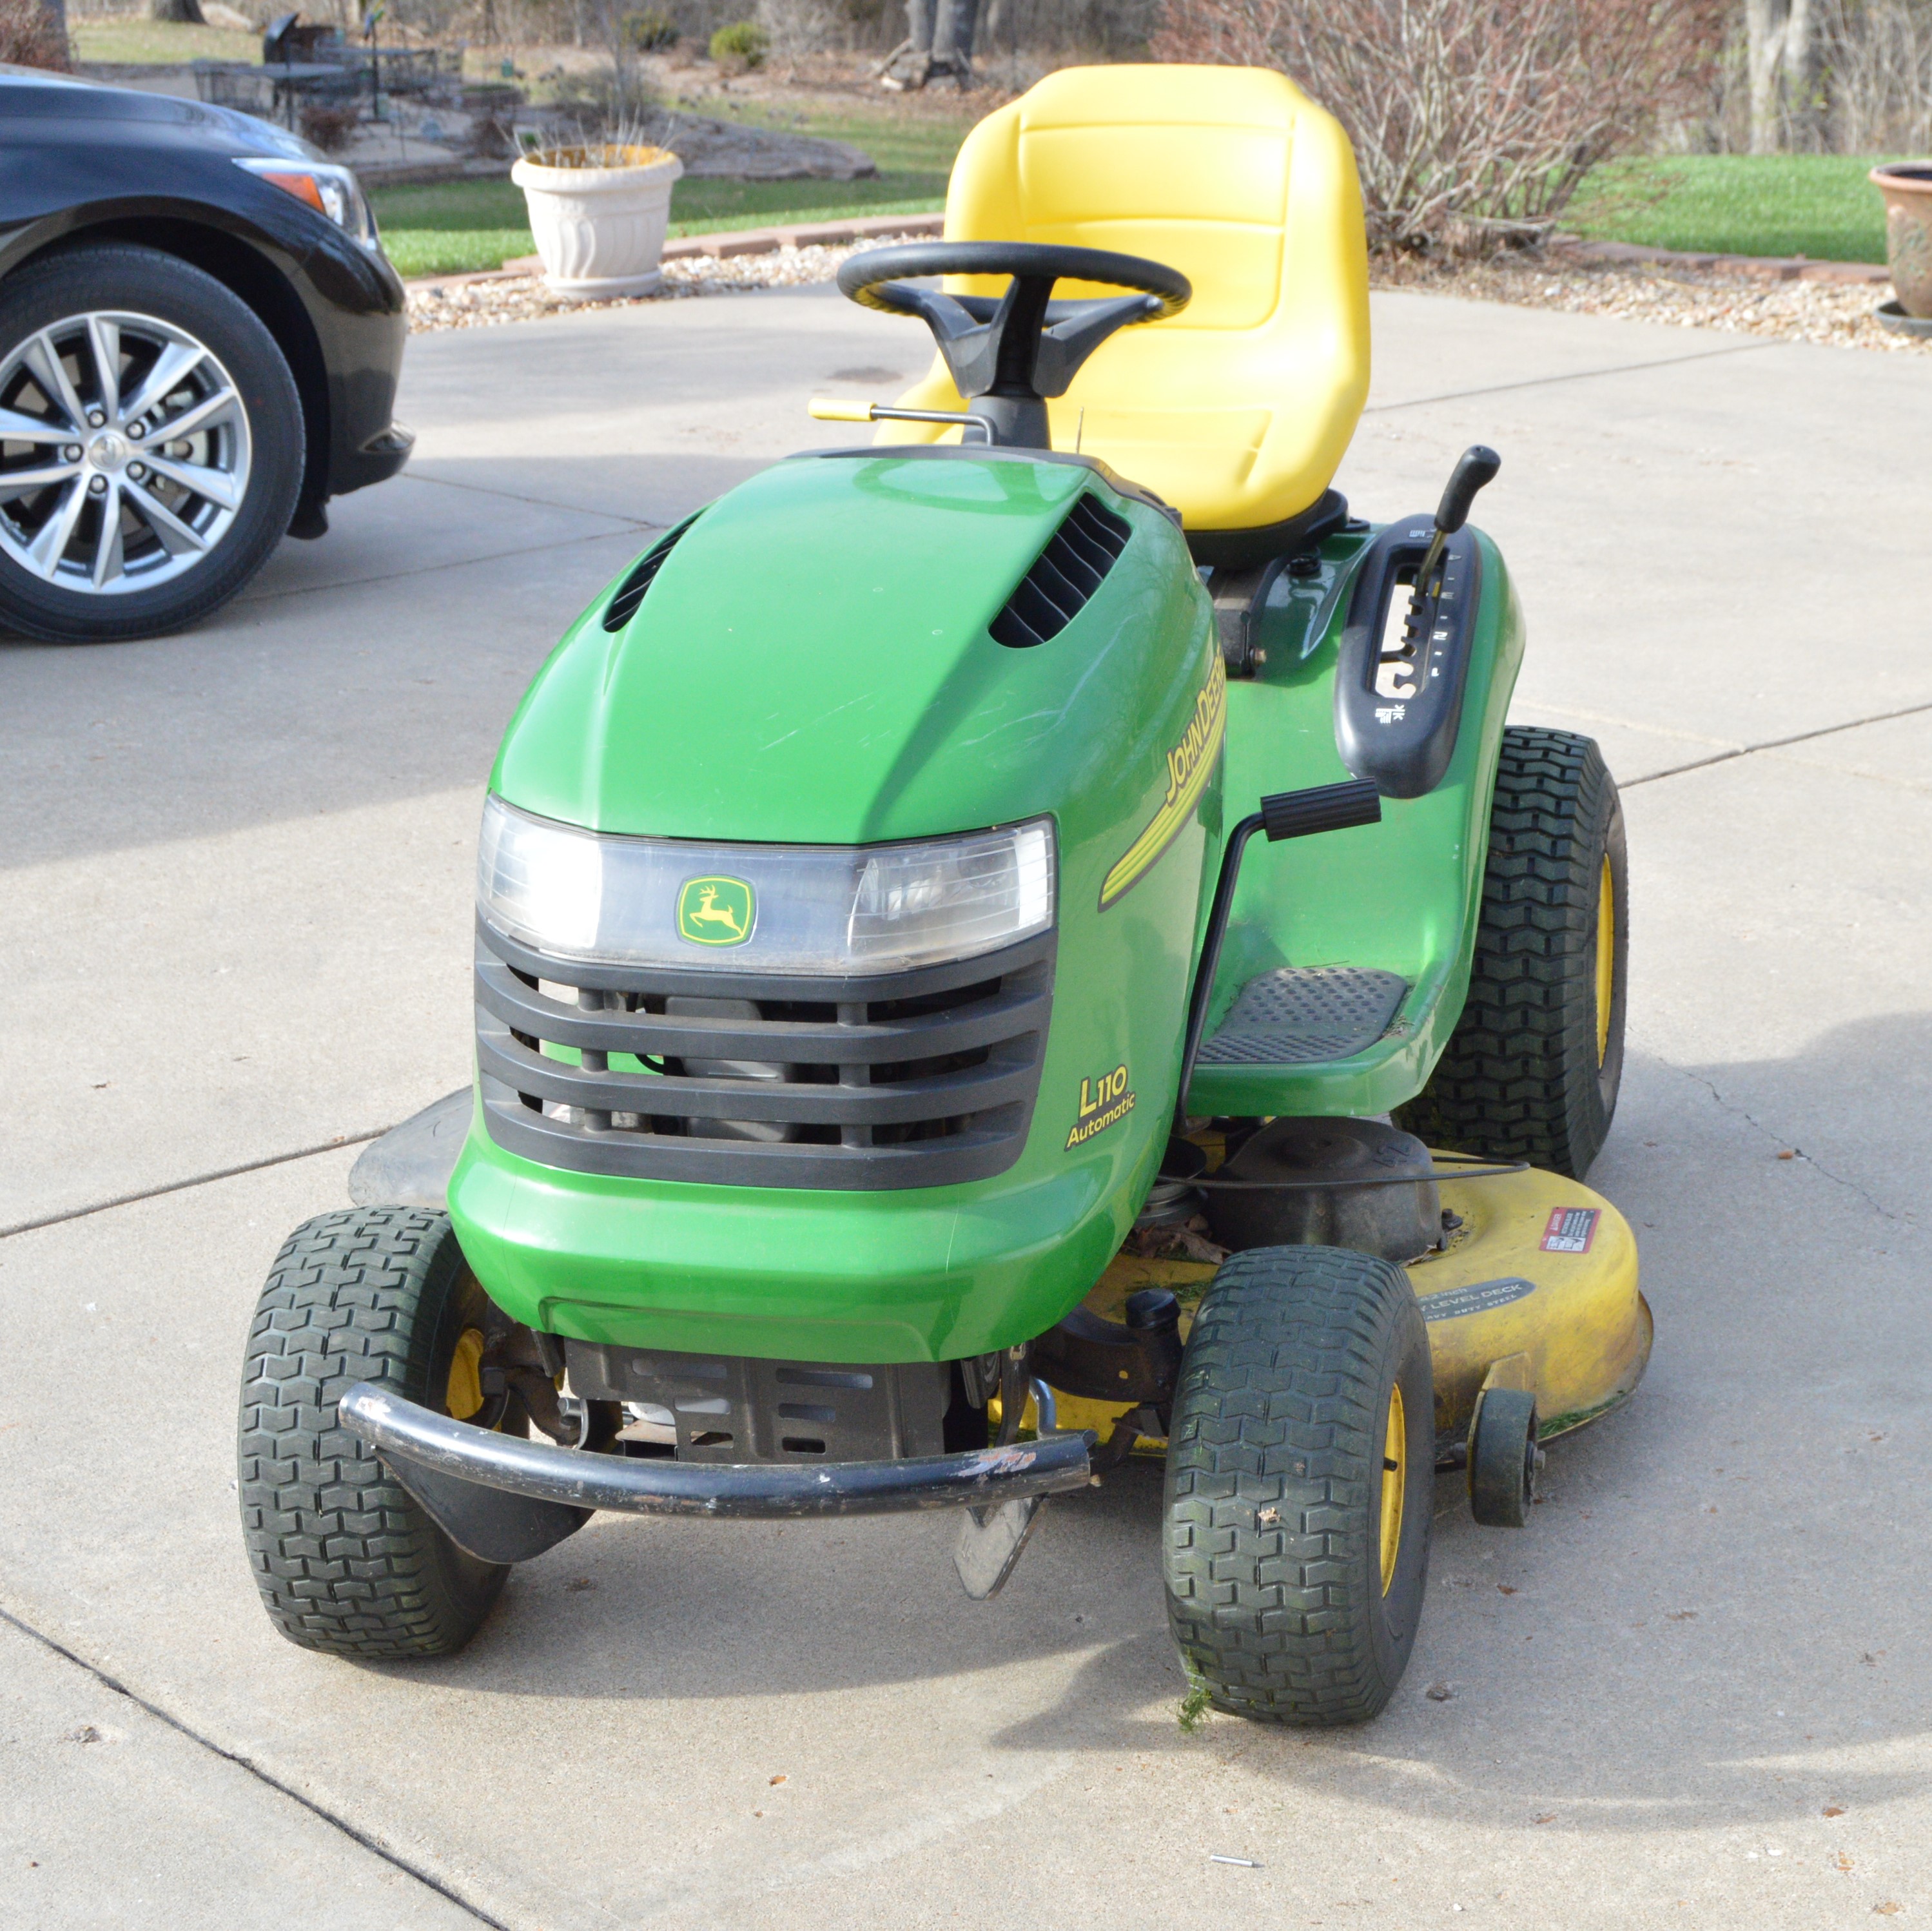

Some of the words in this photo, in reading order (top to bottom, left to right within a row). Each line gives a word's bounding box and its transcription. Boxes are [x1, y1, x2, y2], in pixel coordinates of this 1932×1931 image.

[1433, 632, 1448, 641] 2
[1431, 667, 1439, 677] 1
[1166, 713, 1203, 804] JOHN
[1080, 1065, 1127, 1118] L110
[1066, 1093, 1135, 1148] Automatic
[1430, 1295, 1479, 1309] LEVEL
[1481, 1284, 1523, 1297] DECK
[1440, 1288, 1468, 1297] inch
[1454, 1305, 1481, 1314] DUTY
[1487, 1294, 1517, 1306] STEEL
